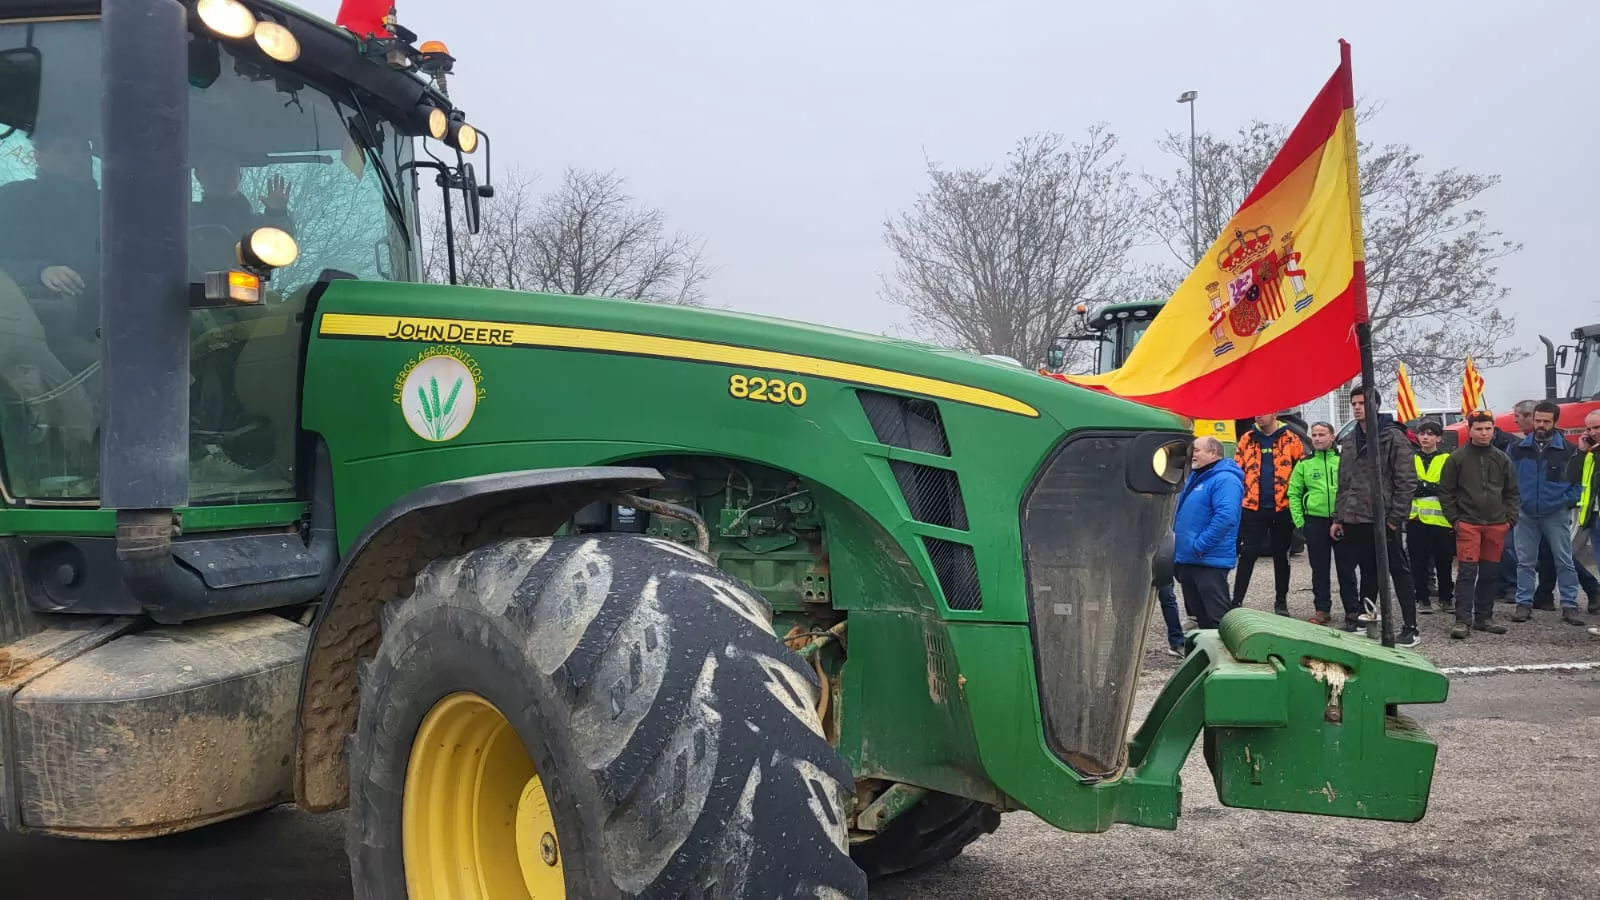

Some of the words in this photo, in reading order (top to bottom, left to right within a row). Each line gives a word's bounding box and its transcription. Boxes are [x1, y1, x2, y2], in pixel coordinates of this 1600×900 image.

[388, 320, 443, 340] JOHN
[448, 323, 514, 343] DEERE
[393, 358, 417, 404] ALBEROS
[418, 345, 484, 383] AGROSERVICIOS
[729, 374, 807, 406] 8230
